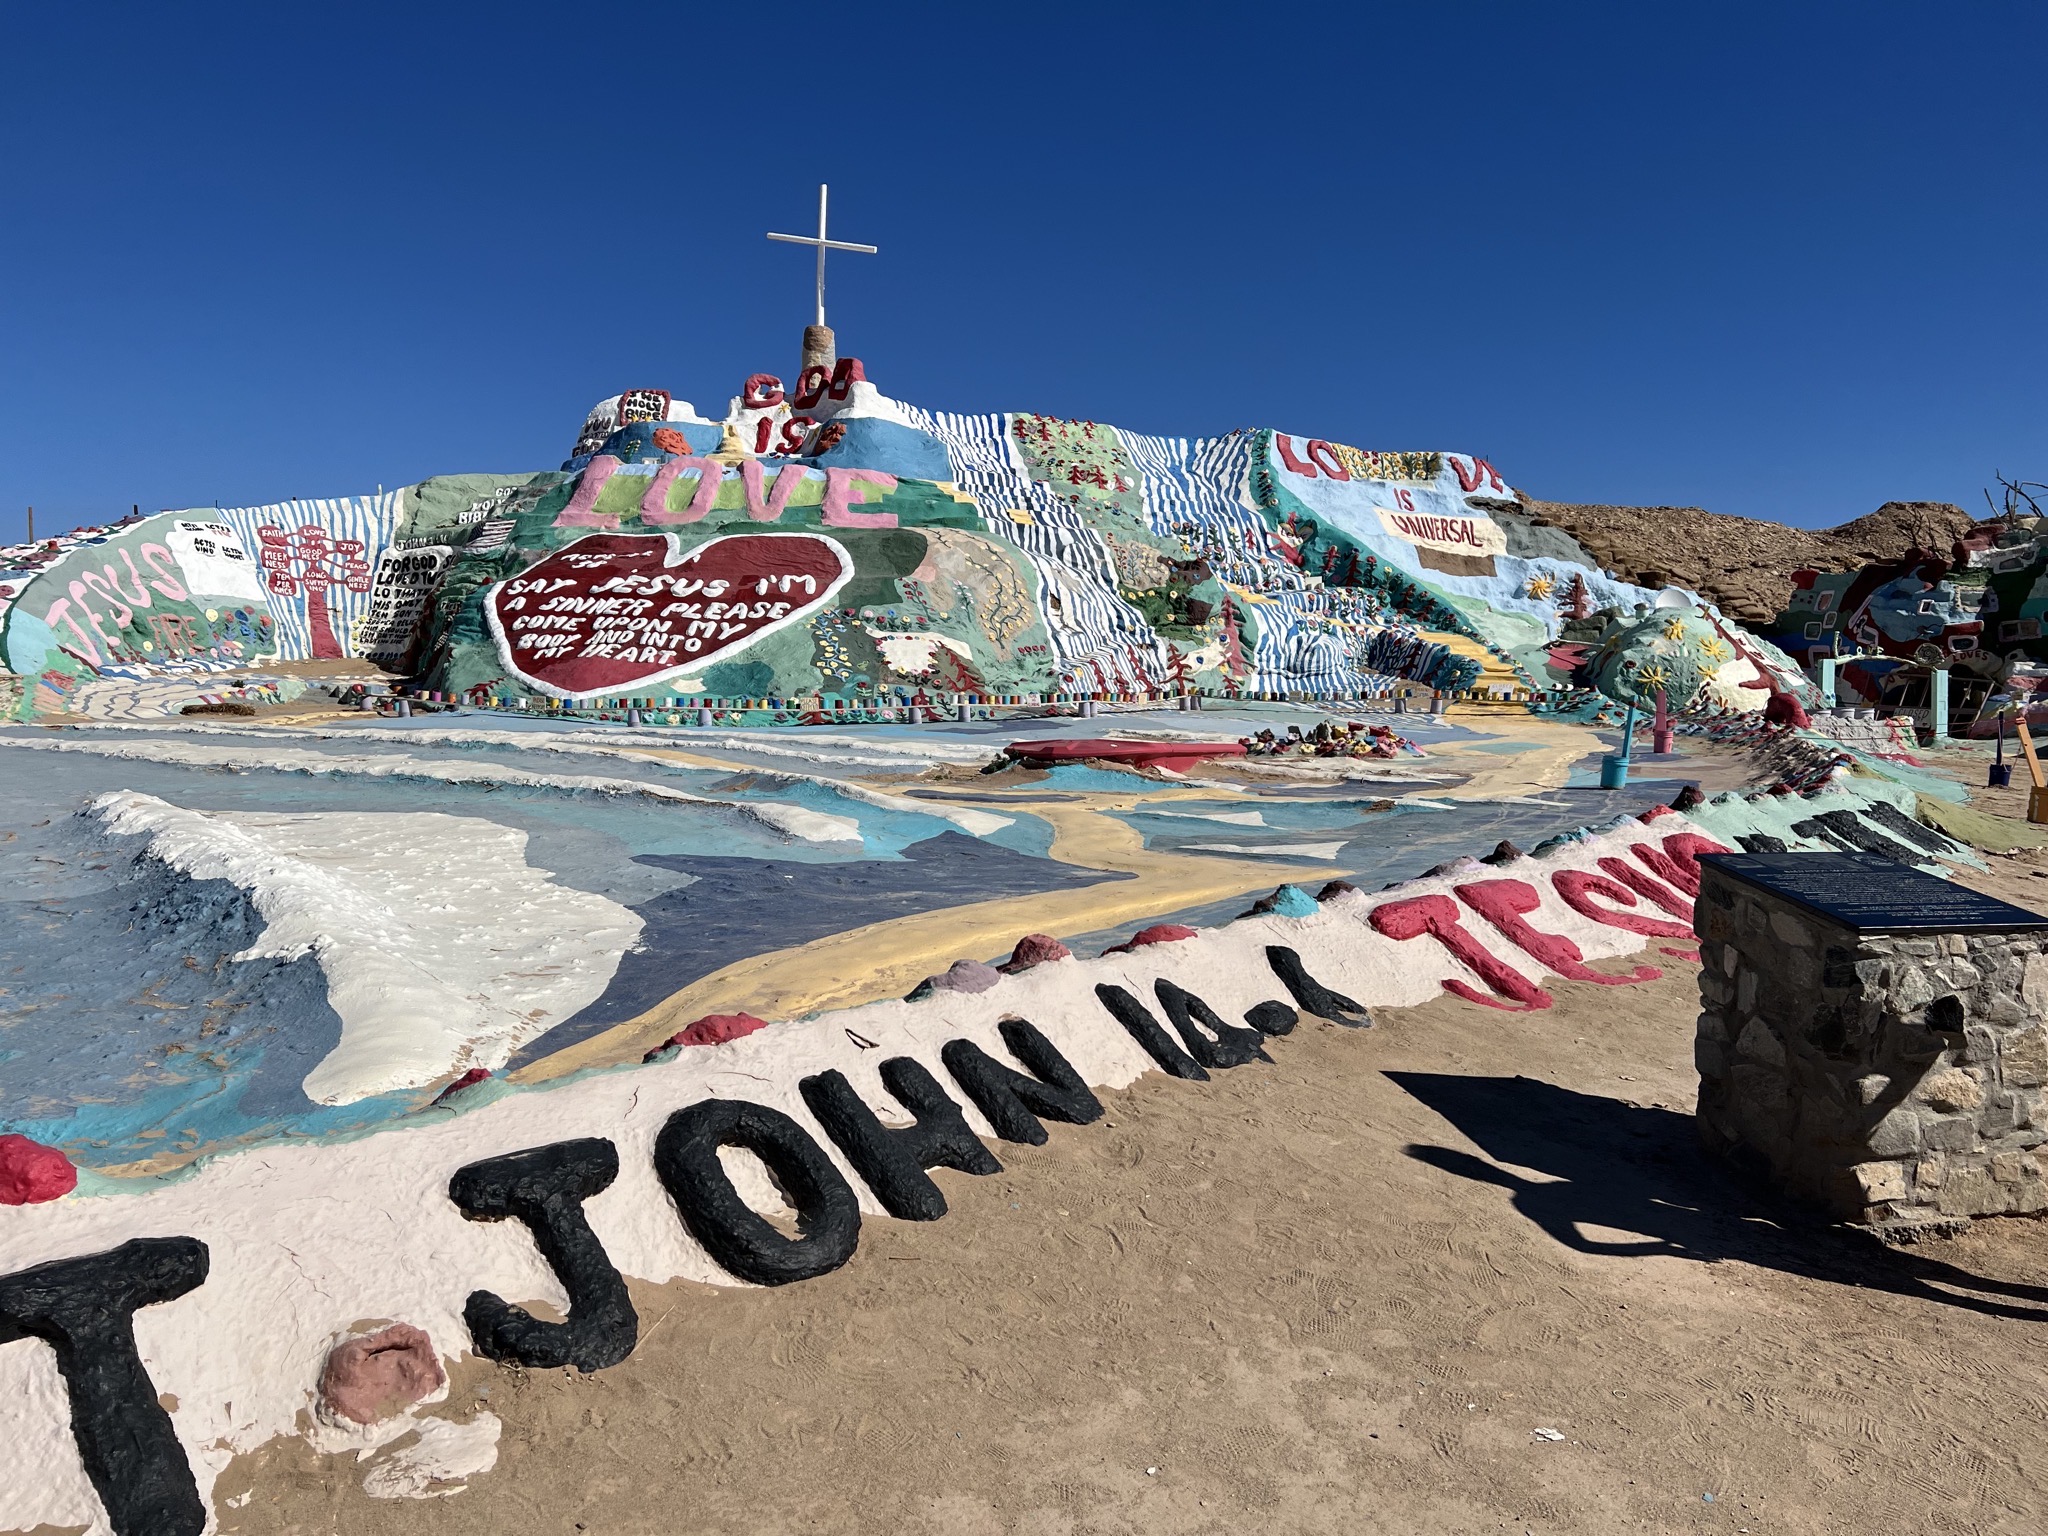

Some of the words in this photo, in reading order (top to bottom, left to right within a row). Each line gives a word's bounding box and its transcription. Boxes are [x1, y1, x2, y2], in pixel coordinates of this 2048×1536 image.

[744, 358, 866, 409] GOD
[626, 399, 662, 411] HOLY
[625, 408, 661, 420] BIBLE
[754, 416, 816, 453] IS
[553, 454, 899, 529] LOVE
[1393, 488, 1415, 512] IS
[261, 529, 284, 538] FAITH
[304, 528, 326, 537] LOVE
[1391, 514, 1483, 547] UNIVERSAL
[300, 548, 323, 556] GOOD
[340, 543, 361, 552] JOY
[264, 551, 288, 561] MEEK
[265, 560, 286, 569] NESS
[345, 562, 368, 570] PEACE
[376, 572, 420, 585] LOVED
[507, 578, 577, 595] SAY
[589, 575, 730, 598] JESUS
[755, 574, 817, 596] I'M
[45, 543, 188, 667] JESUS
[372, 600, 392, 611] HIS
[395, 599, 423, 609] ONLY
[503, 596, 527, 611] A
[538, 596, 654, 616] SINNER
[660, 601, 792, 621] PLEASE
[393, 610, 413, 619] SON
[512, 615, 587, 631] COME
[592, 616, 673, 633] UPON
[686, 620, 747, 640] MY
[516, 633, 582, 649] BODY
[585, 629, 635, 645] AND
[639, 631, 702, 652] INTO
[533, 646, 575, 660] MY
[1952, 650, 1990, 663] LOVES
[449, 1016, 1105, 1373] JOHN
